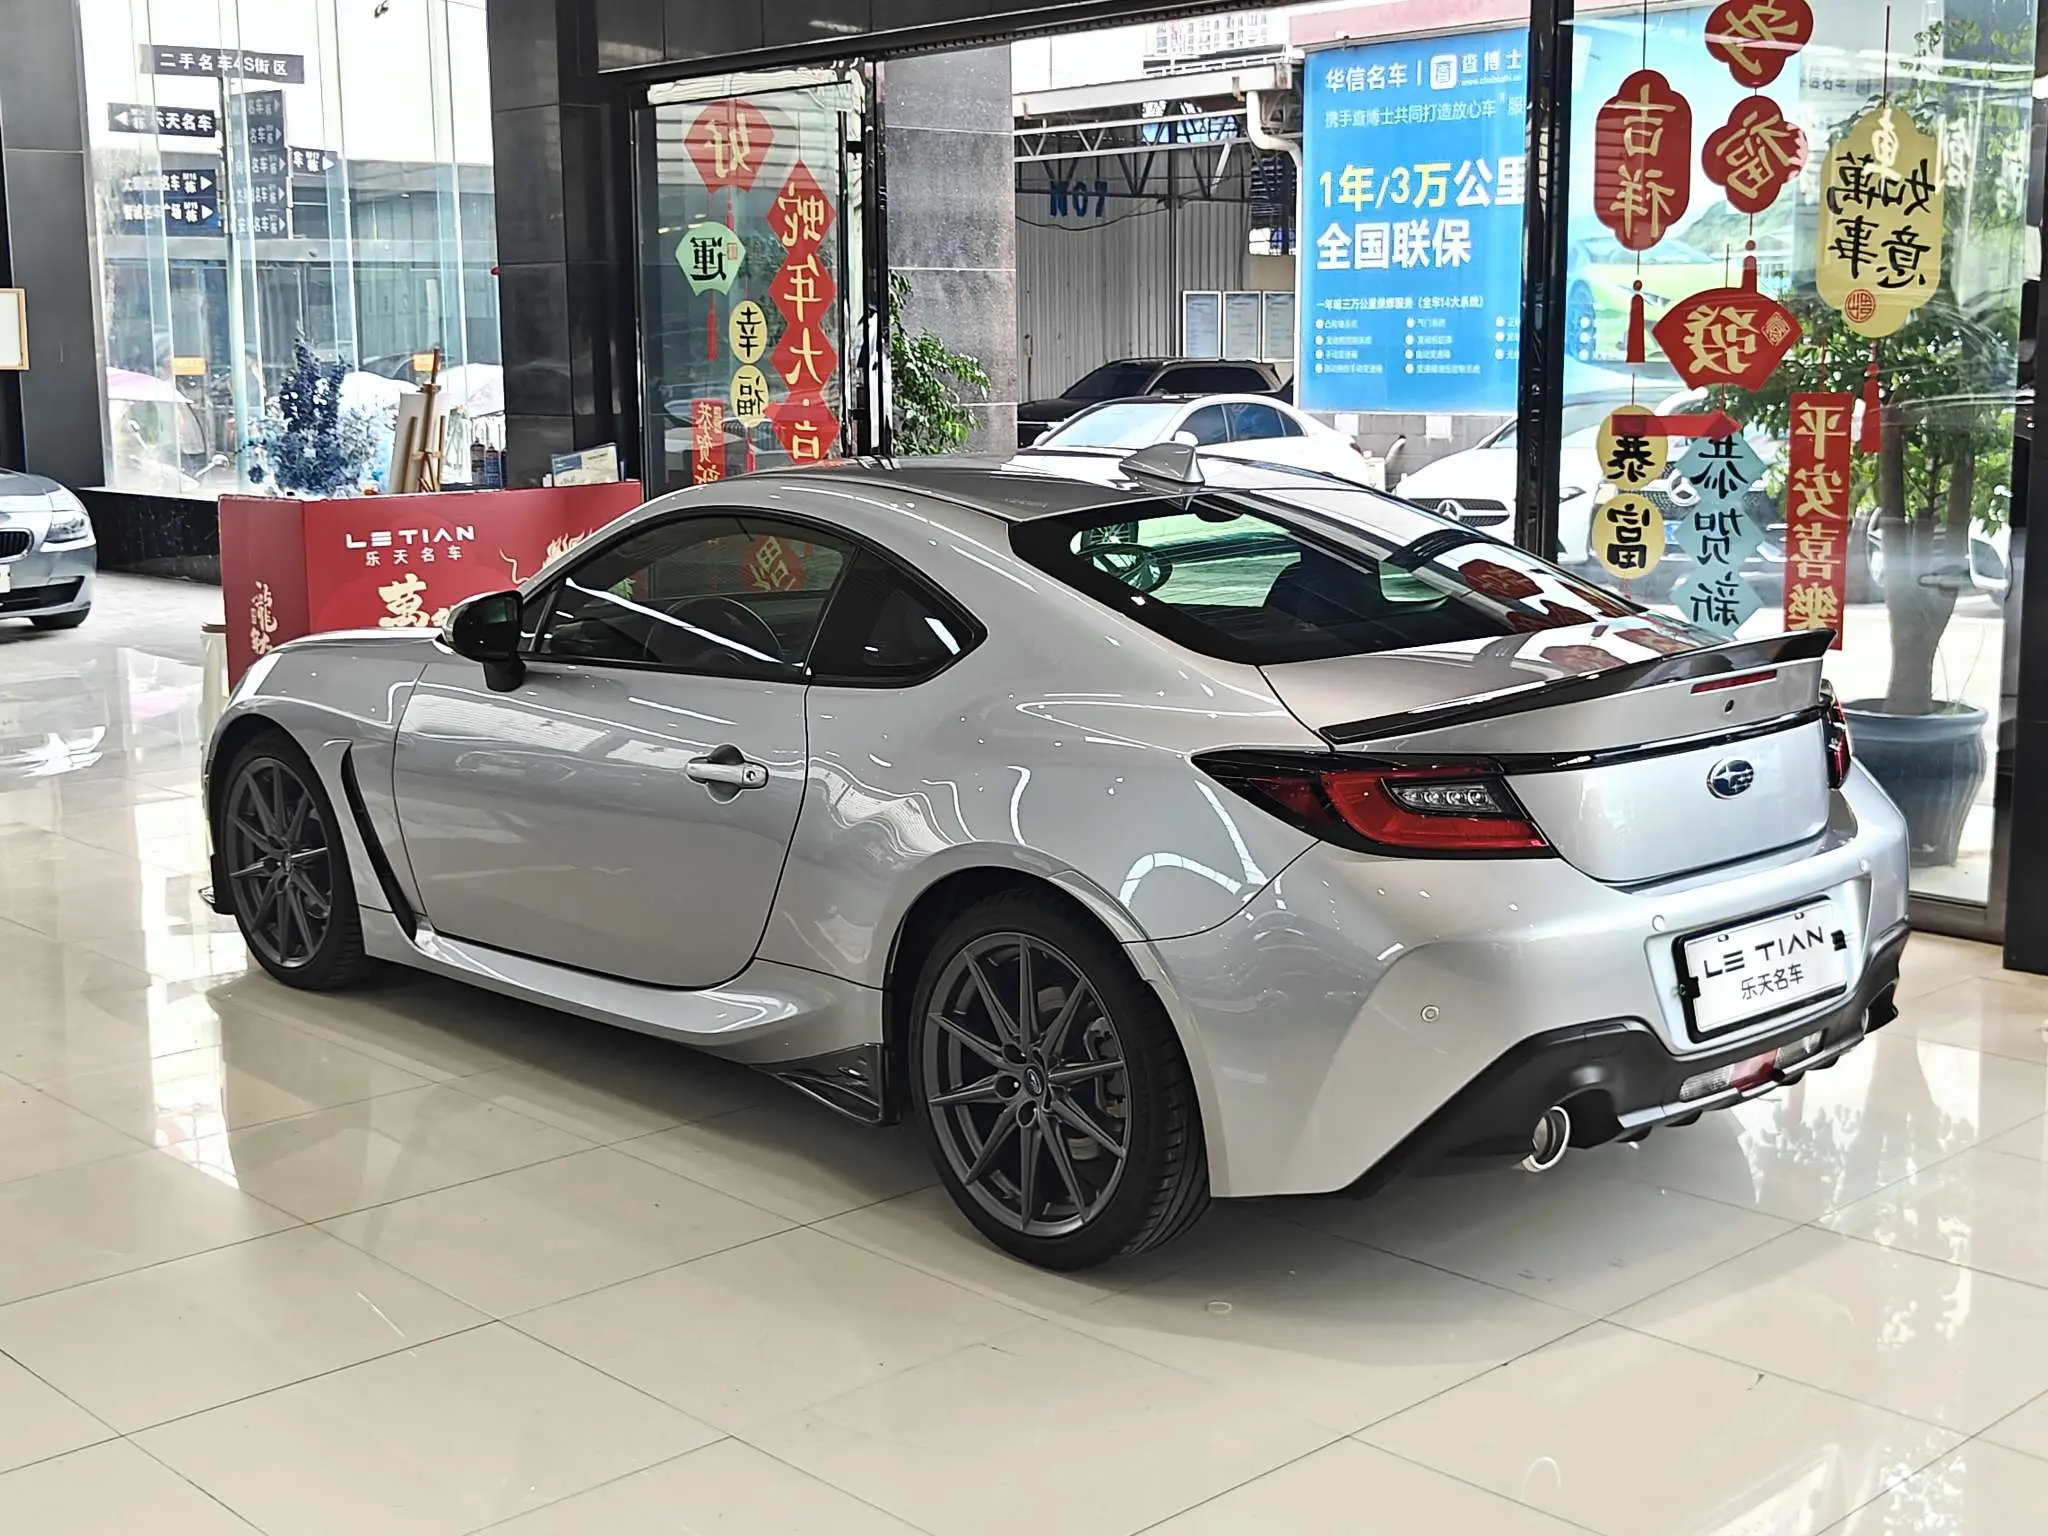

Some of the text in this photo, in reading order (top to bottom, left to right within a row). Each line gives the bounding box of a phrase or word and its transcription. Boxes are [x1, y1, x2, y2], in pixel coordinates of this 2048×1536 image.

[1462, 49, 1522, 74] 查博士
[1326, 62, 1408, 93] 华信名车
[1319, 155, 1525, 213] 1年/3万公里
[1316, 217, 1472, 270] 全国联保
[345, 525, 476, 549] LETIAN
[365, 545, 463, 568] 乐天名车
[1740, 963, 1805, 1001] 乐天名车
